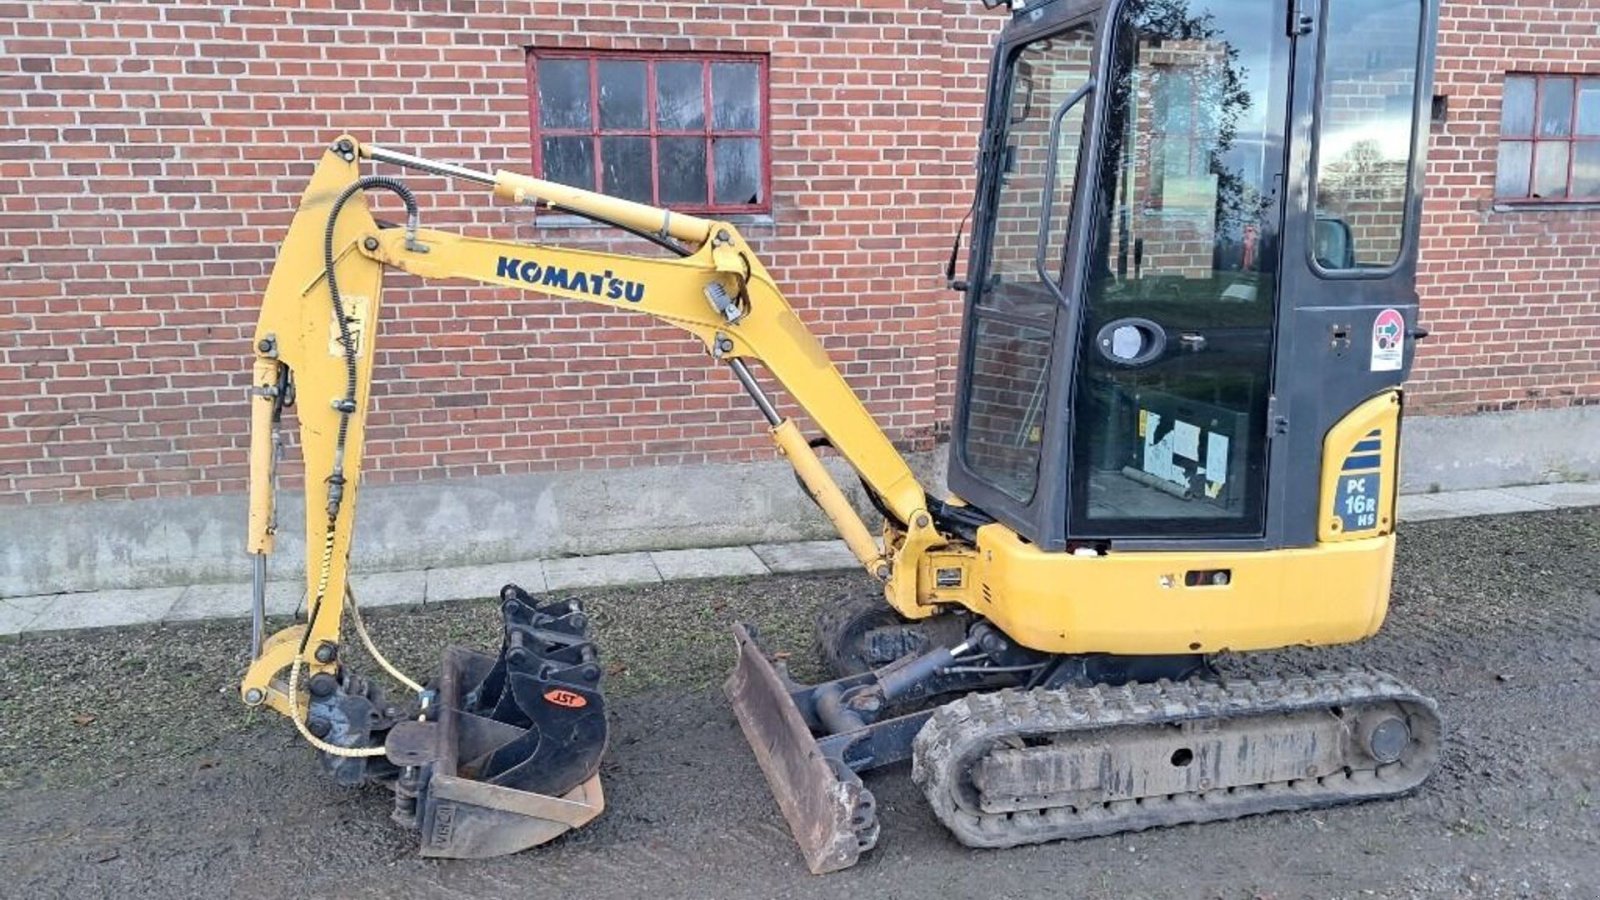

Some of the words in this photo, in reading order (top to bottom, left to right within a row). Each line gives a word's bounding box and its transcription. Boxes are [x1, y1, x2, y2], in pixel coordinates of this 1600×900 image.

[497, 256, 645, 302] KOMATSU
[1347, 478, 1366, 494] PC
[1345, 495, 1376, 515] 16R
[1358, 513, 1375, 526] HS
